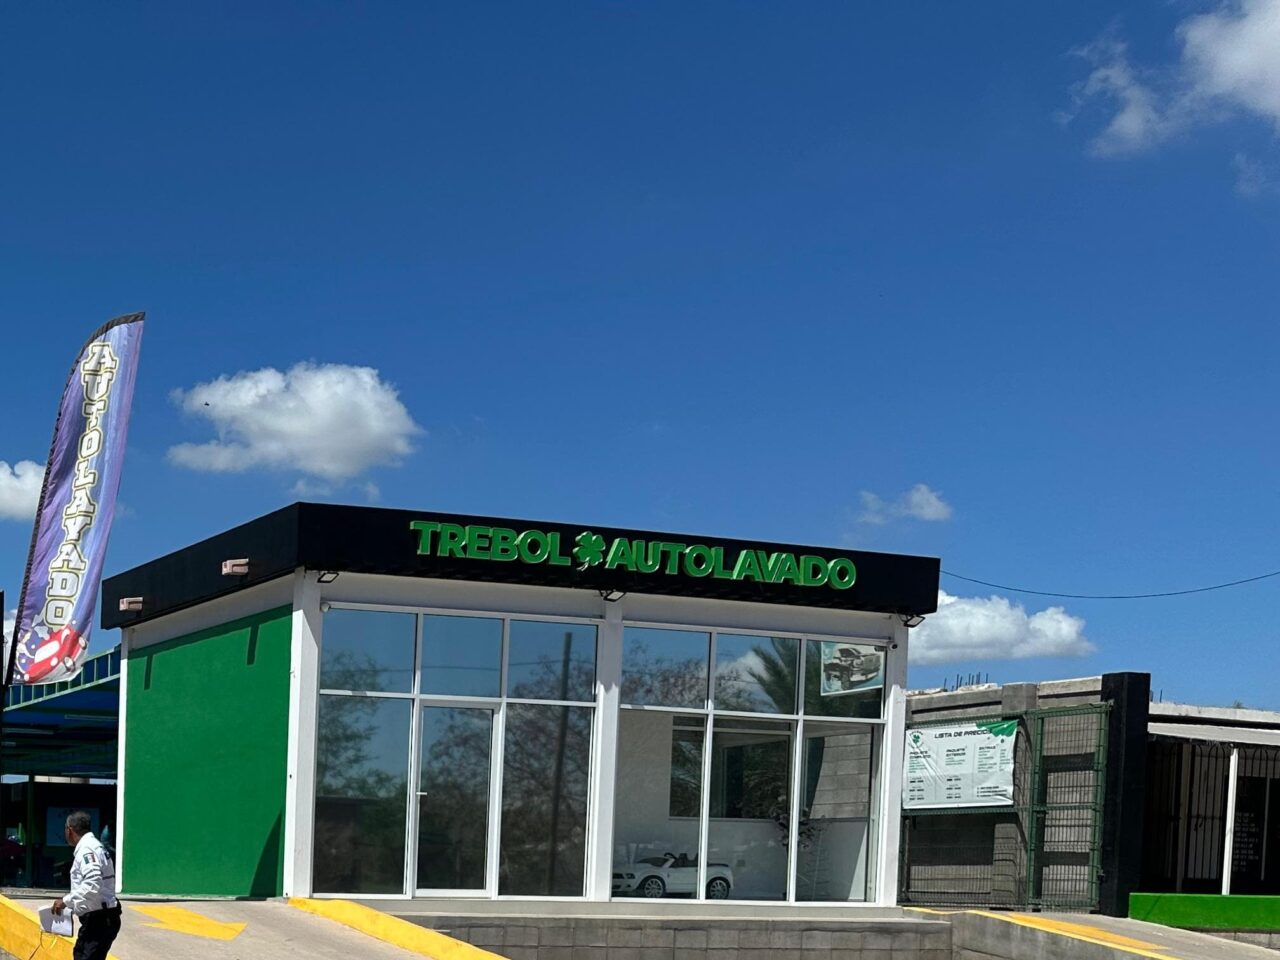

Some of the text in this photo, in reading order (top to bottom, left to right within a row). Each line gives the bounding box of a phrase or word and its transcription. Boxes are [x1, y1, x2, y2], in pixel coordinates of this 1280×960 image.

[45, 341, 118, 629] AUTOLAVADO
[410, 520, 857, 590] TREBOL AUTOLAVADO
